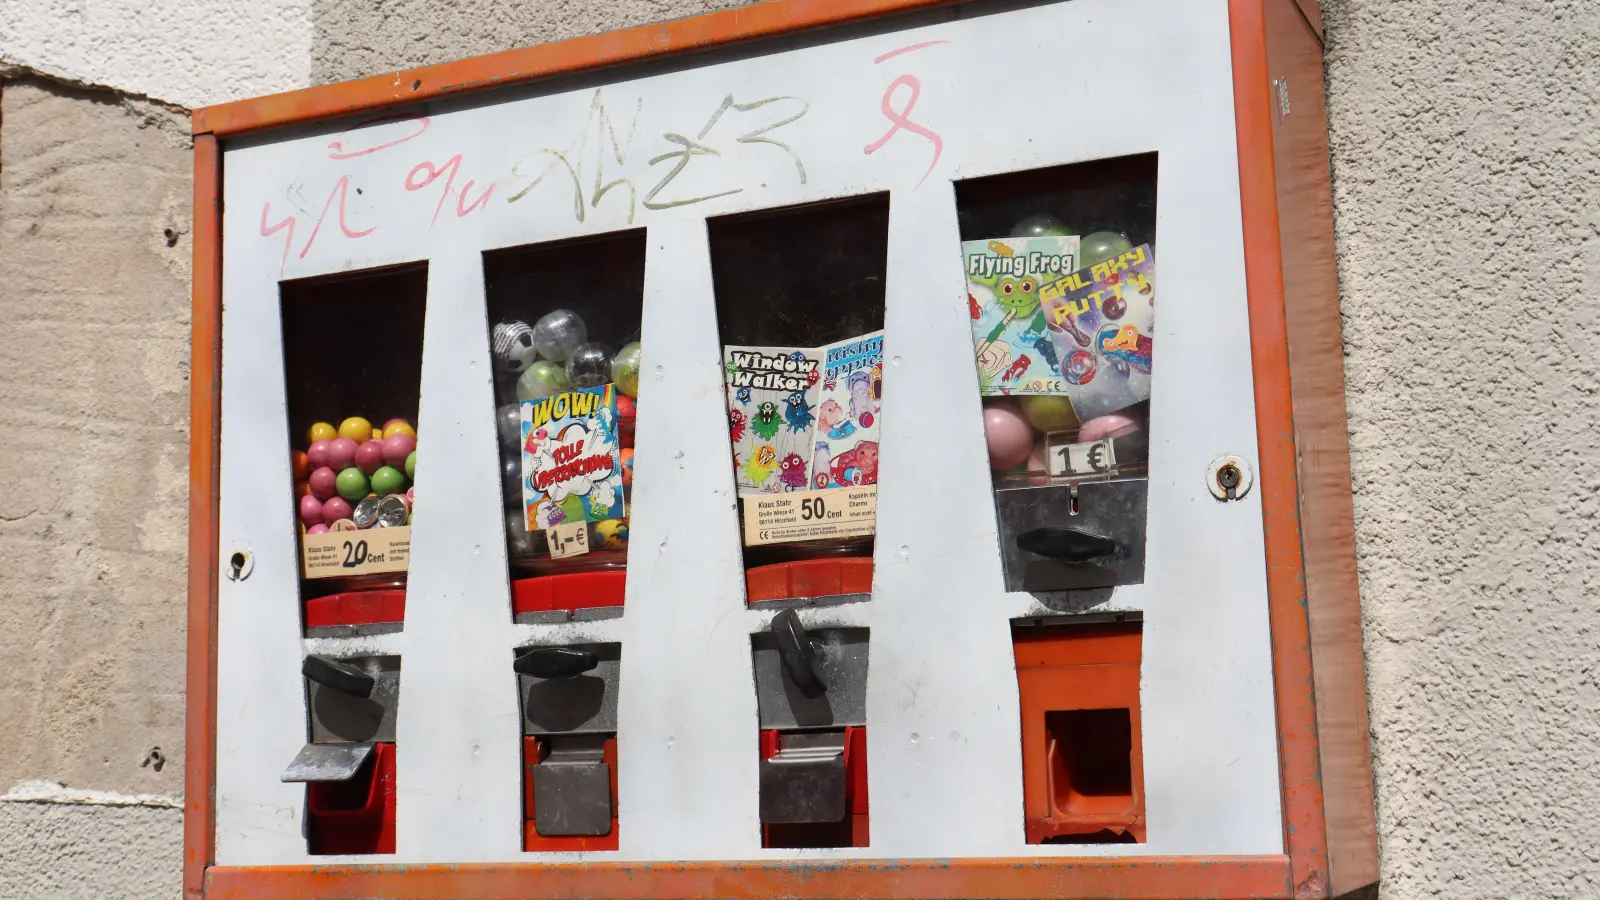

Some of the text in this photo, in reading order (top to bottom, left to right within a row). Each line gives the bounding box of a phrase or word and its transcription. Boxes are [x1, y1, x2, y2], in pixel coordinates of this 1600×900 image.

[969, 251, 1074, 279] Flying Frog
[1053, 274, 1147, 325] PUTTY
[731, 350, 819, 373] Window
[732, 371, 810, 392] Walker
[532, 391, 600, 428] WOW!
[552, 439, 585, 466] TOLLE
[1057, 443, 1107, 475] 1 €
[801, 497, 843, 520] 50 Cent
[343, 539, 385, 568] 20 Cent
